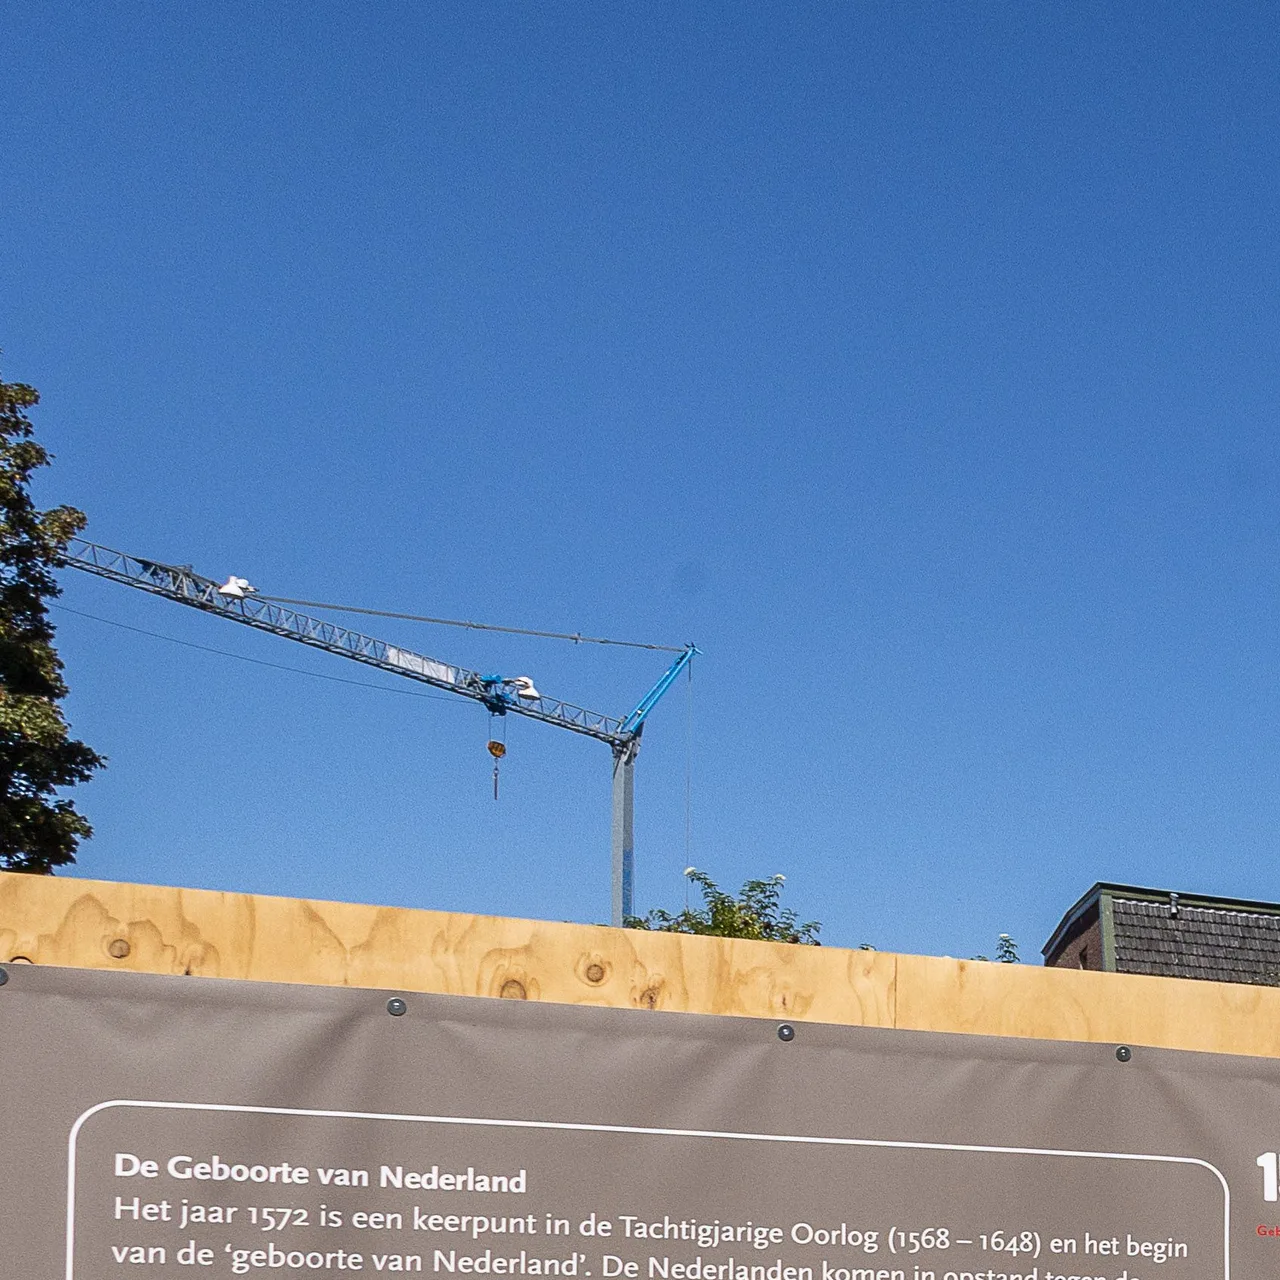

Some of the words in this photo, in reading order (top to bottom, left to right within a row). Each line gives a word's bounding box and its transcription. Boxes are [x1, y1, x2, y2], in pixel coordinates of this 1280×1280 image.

[115, 1153, 159, 1178] De
[167, 1155, 309, 1184] Geboorte
[317, 1168, 368, 1187] van
[380, 1165, 526, 1193] Nederland
[111, 1246, 165, 1264] van
[177, 1240, 214, 1266] de
[225, 1242, 363, 1274] ‘geboorte
[372, 1254, 422, 1271] van
[434, 1249, 591, 1276] Nederland’.
[603, 1255, 639, 1278] De
